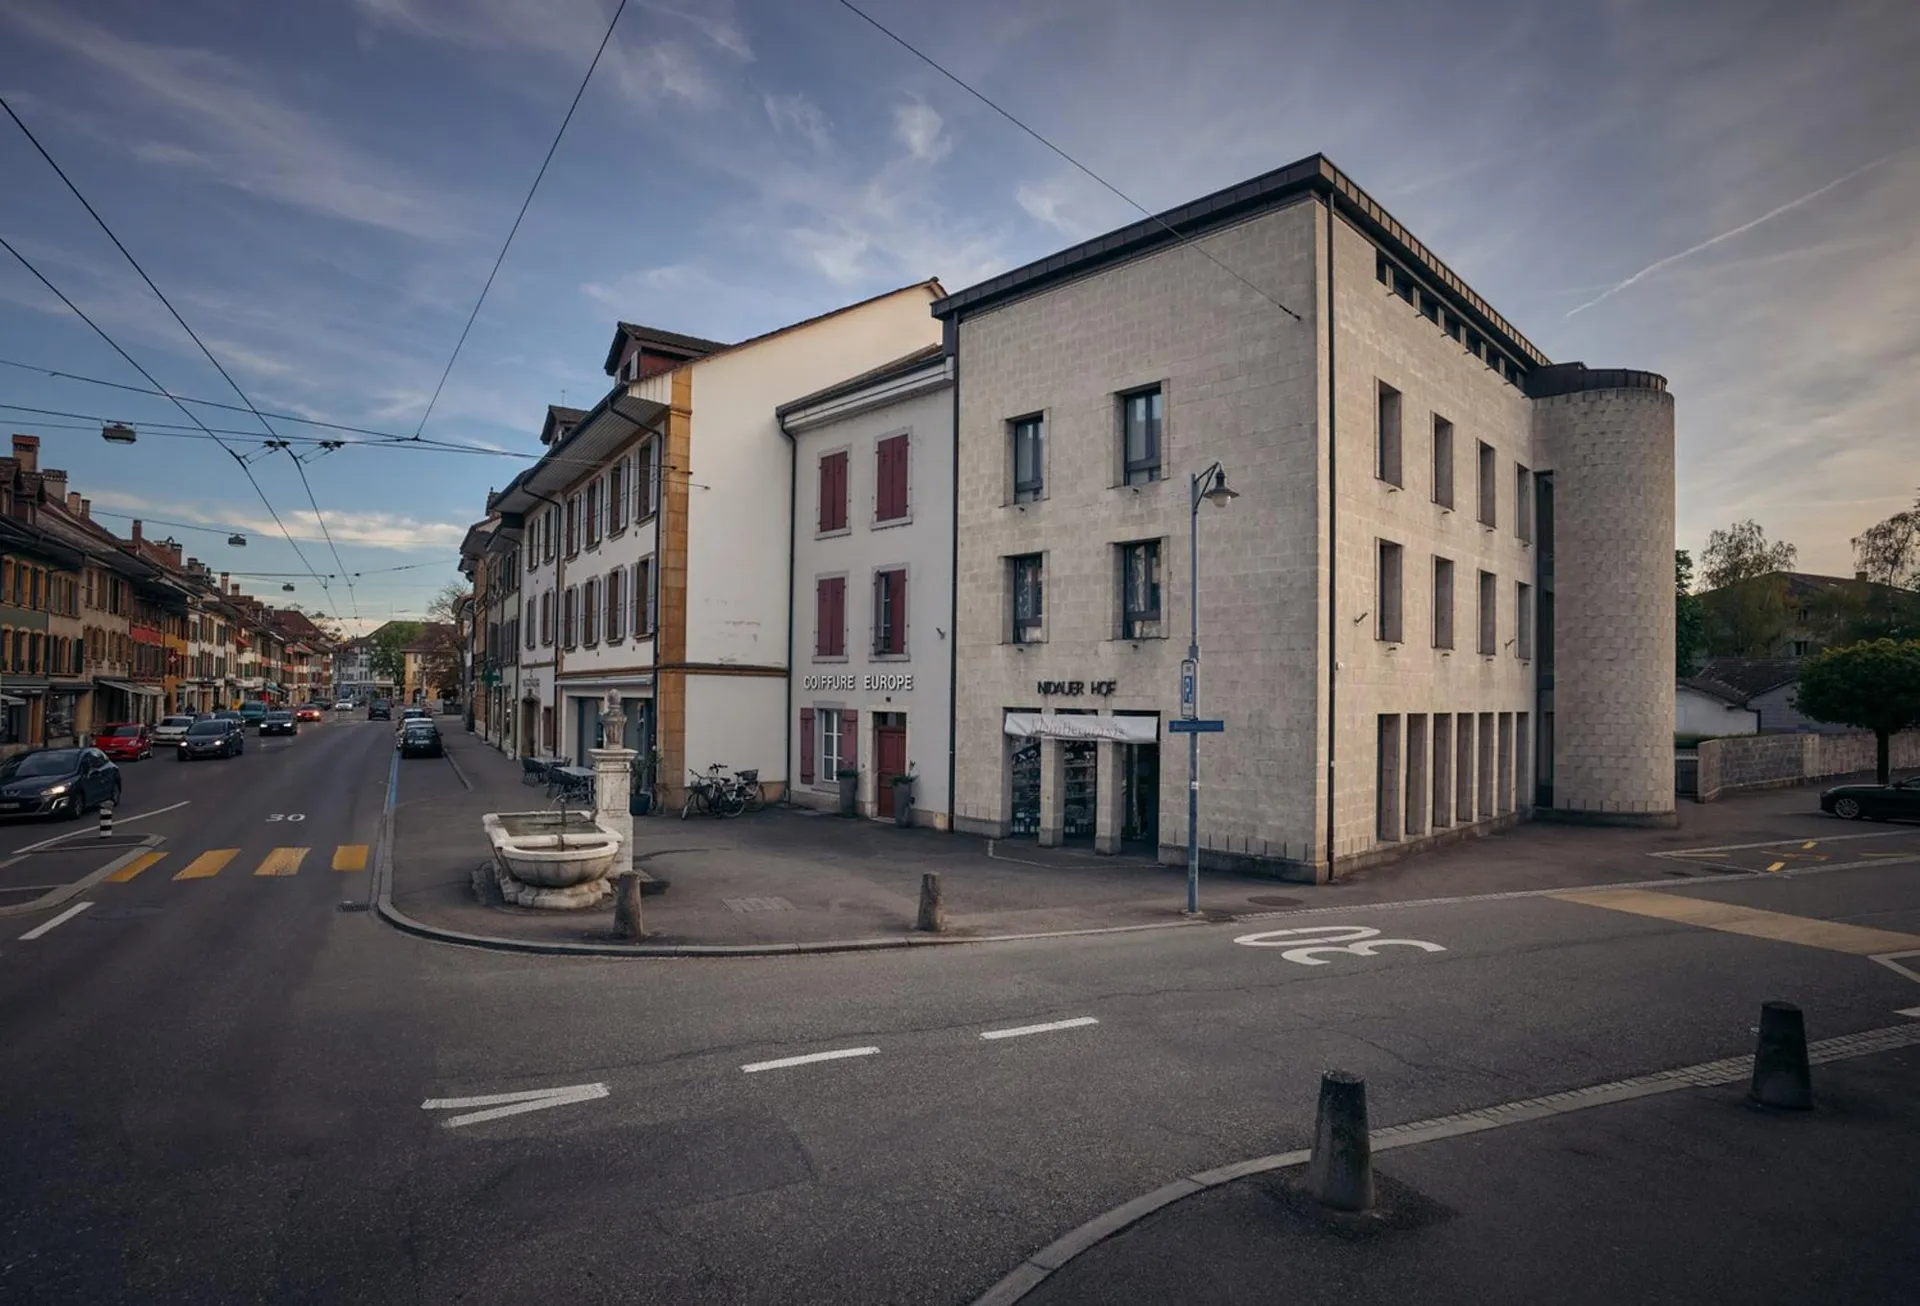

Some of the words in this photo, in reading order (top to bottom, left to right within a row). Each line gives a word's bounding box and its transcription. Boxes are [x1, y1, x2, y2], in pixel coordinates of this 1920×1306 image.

[803, 675, 855, 690] COIFFURE
[864, 675, 914, 690] EUROPE
[1037, 681, 1084, 696] NIDAUER
[1091, 680, 1116, 696] HOF
[265, 813, 306, 822] 30
[1233, 926, 1448, 966] 30
